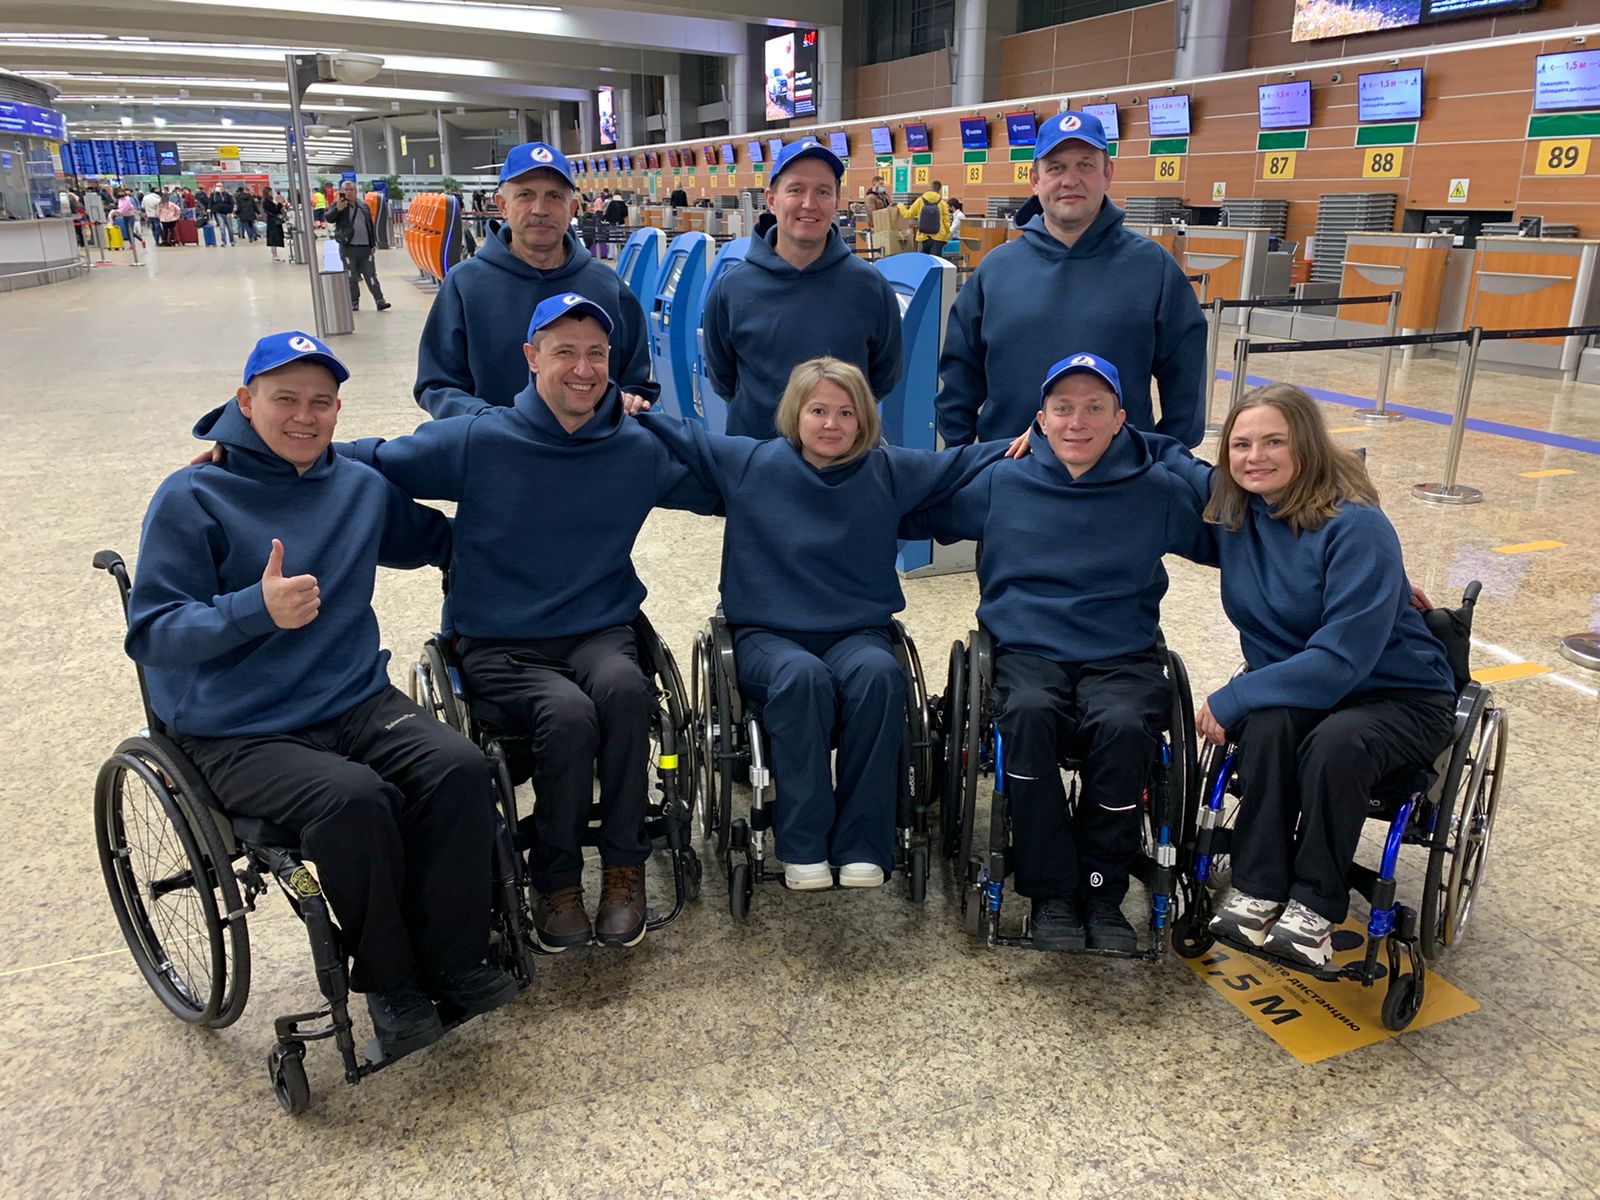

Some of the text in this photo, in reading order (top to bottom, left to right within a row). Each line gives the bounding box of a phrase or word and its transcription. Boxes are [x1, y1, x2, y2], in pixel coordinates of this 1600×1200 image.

[1270, 157, 1289, 174] 87
[1371, 153, 1394, 172] 88
[1547, 146, 1580, 169] 89
[917, 170, 926, 182] 82
[970, 168, 980, 181] 83
[1017, 166, 1028, 179] 84
[1160, 161, 1175, 177] 86
[1201, 952, 1262, 991] 1,5
[1249, 994, 1303, 1026] М
[1287, 978, 1360, 1032] дистанцию
